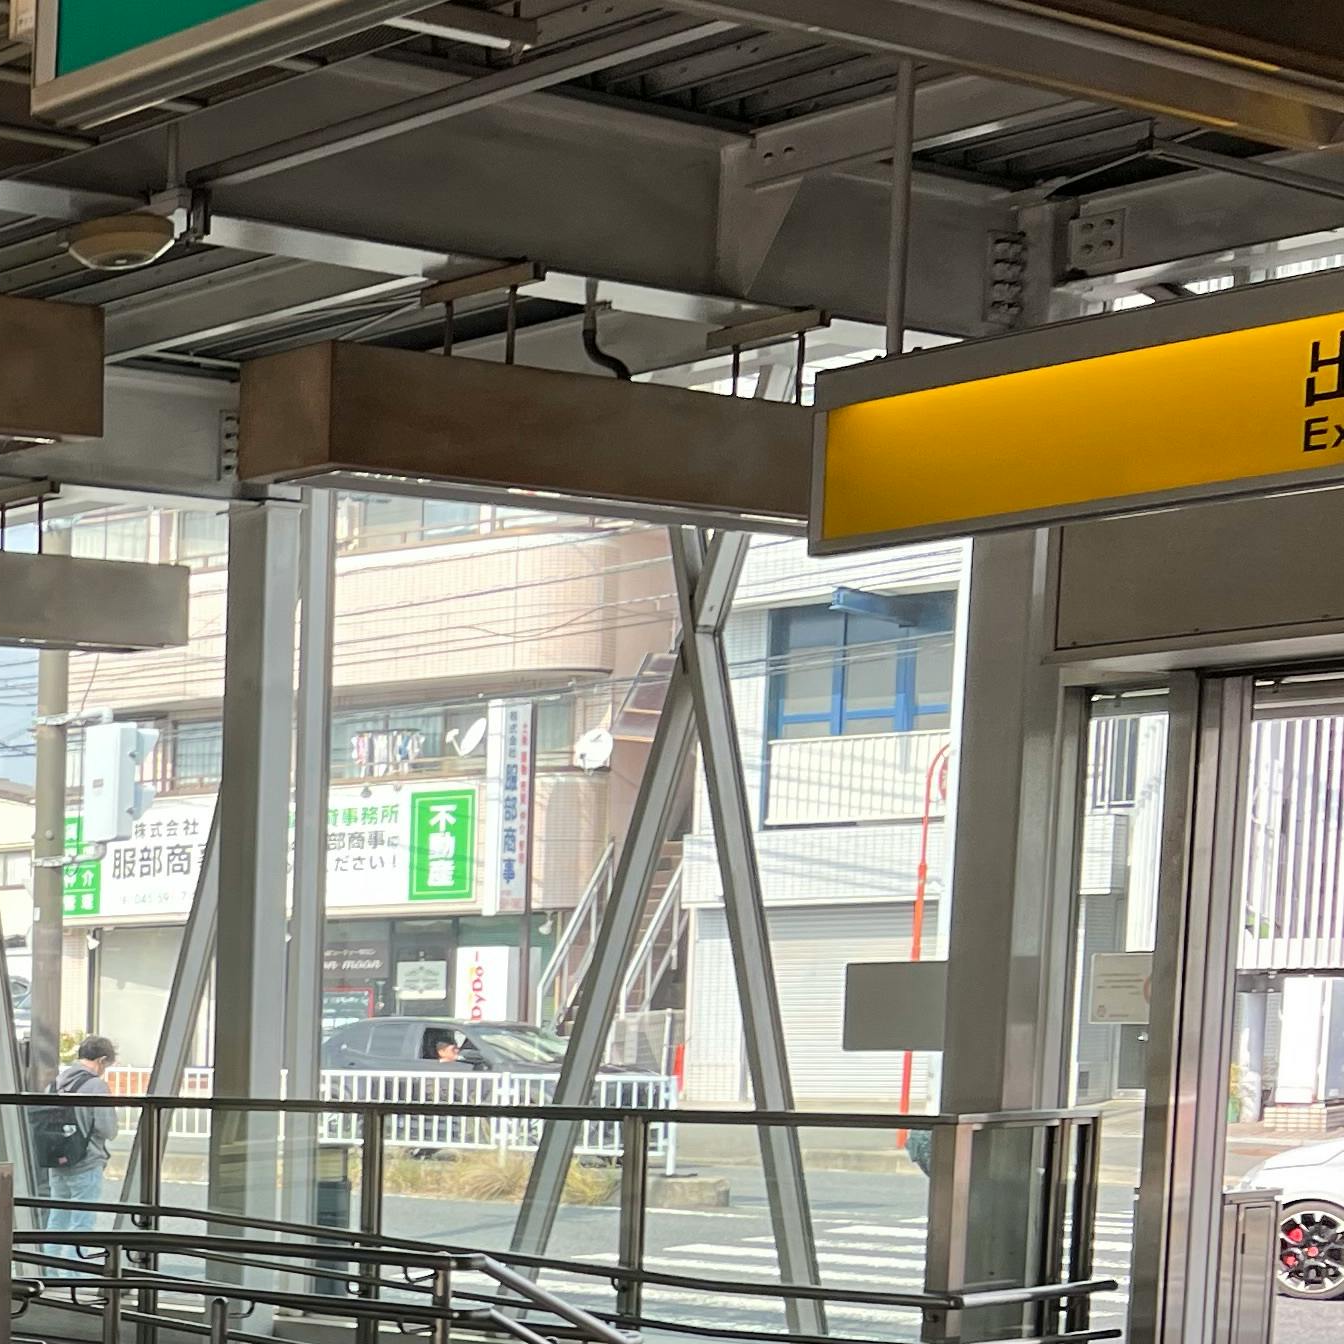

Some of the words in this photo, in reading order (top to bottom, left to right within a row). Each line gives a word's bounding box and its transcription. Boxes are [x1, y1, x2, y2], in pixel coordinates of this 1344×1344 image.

[135, 818, 199, 839] 株式会社
[427, 804, 458, 887] 不動産
